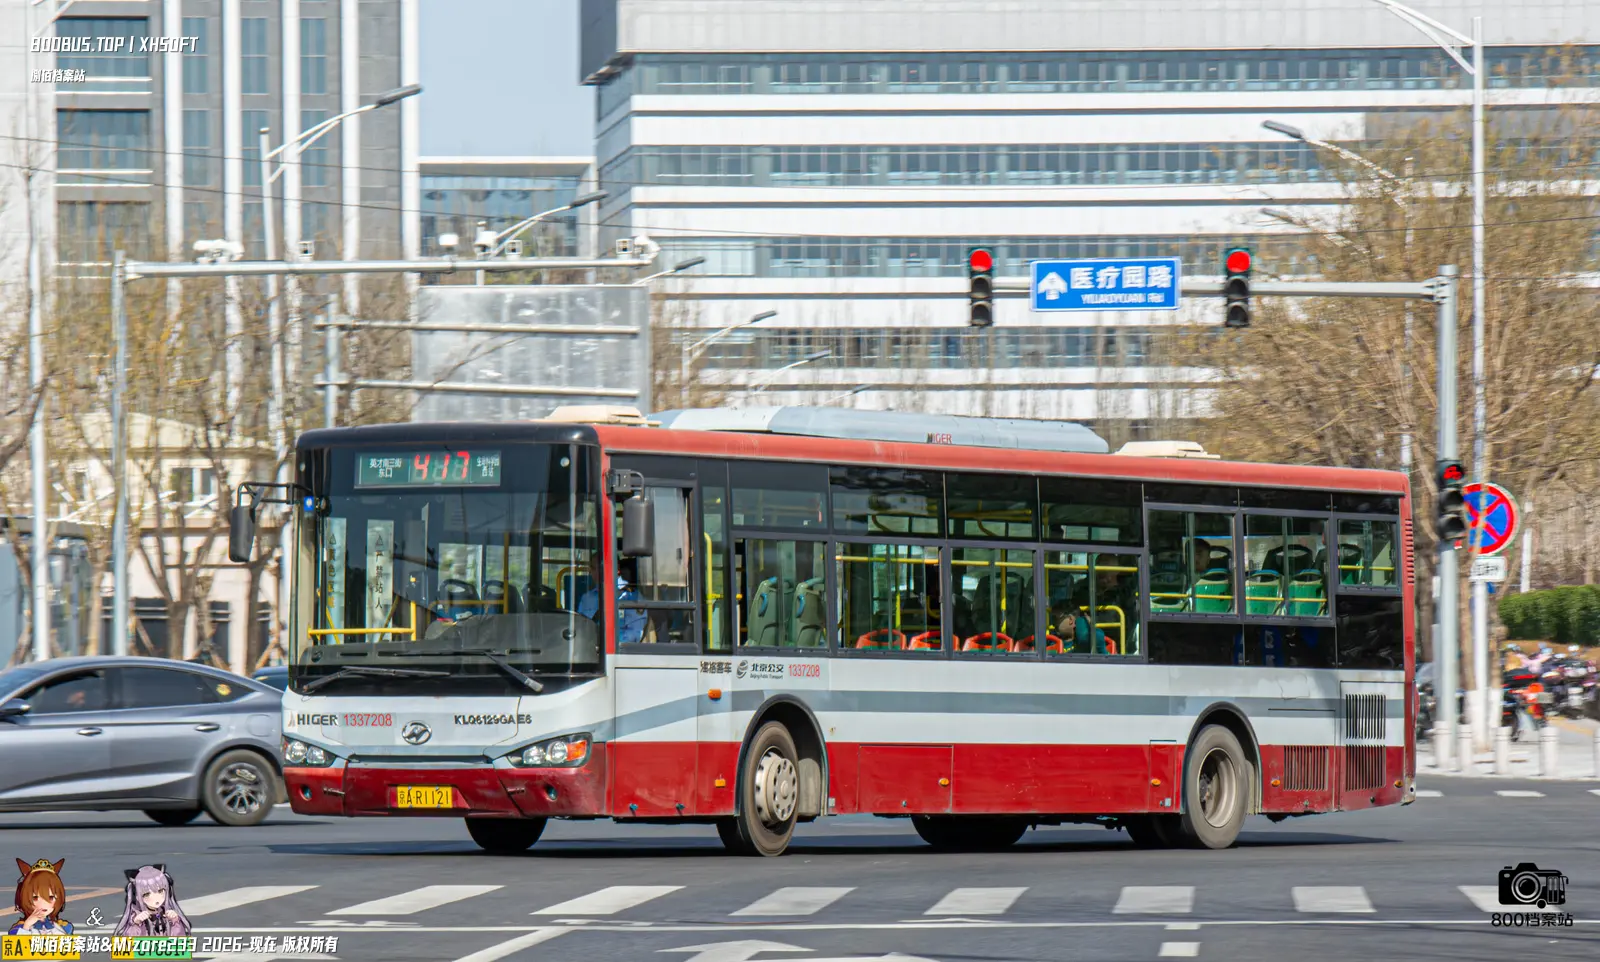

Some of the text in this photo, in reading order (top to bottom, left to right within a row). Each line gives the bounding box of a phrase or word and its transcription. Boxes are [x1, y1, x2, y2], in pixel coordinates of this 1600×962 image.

[1070, 265, 1173, 289] 医疗园路
[378, 467, 393, 478] 东口
[414, 451, 470, 480] 417
[375, 551, 384, 609] 严禁站人
[750, 663, 784, 673] 北京公交
[788, 664, 820, 677] 1337208
[297, 713, 393, 727] HIGER 1337208
